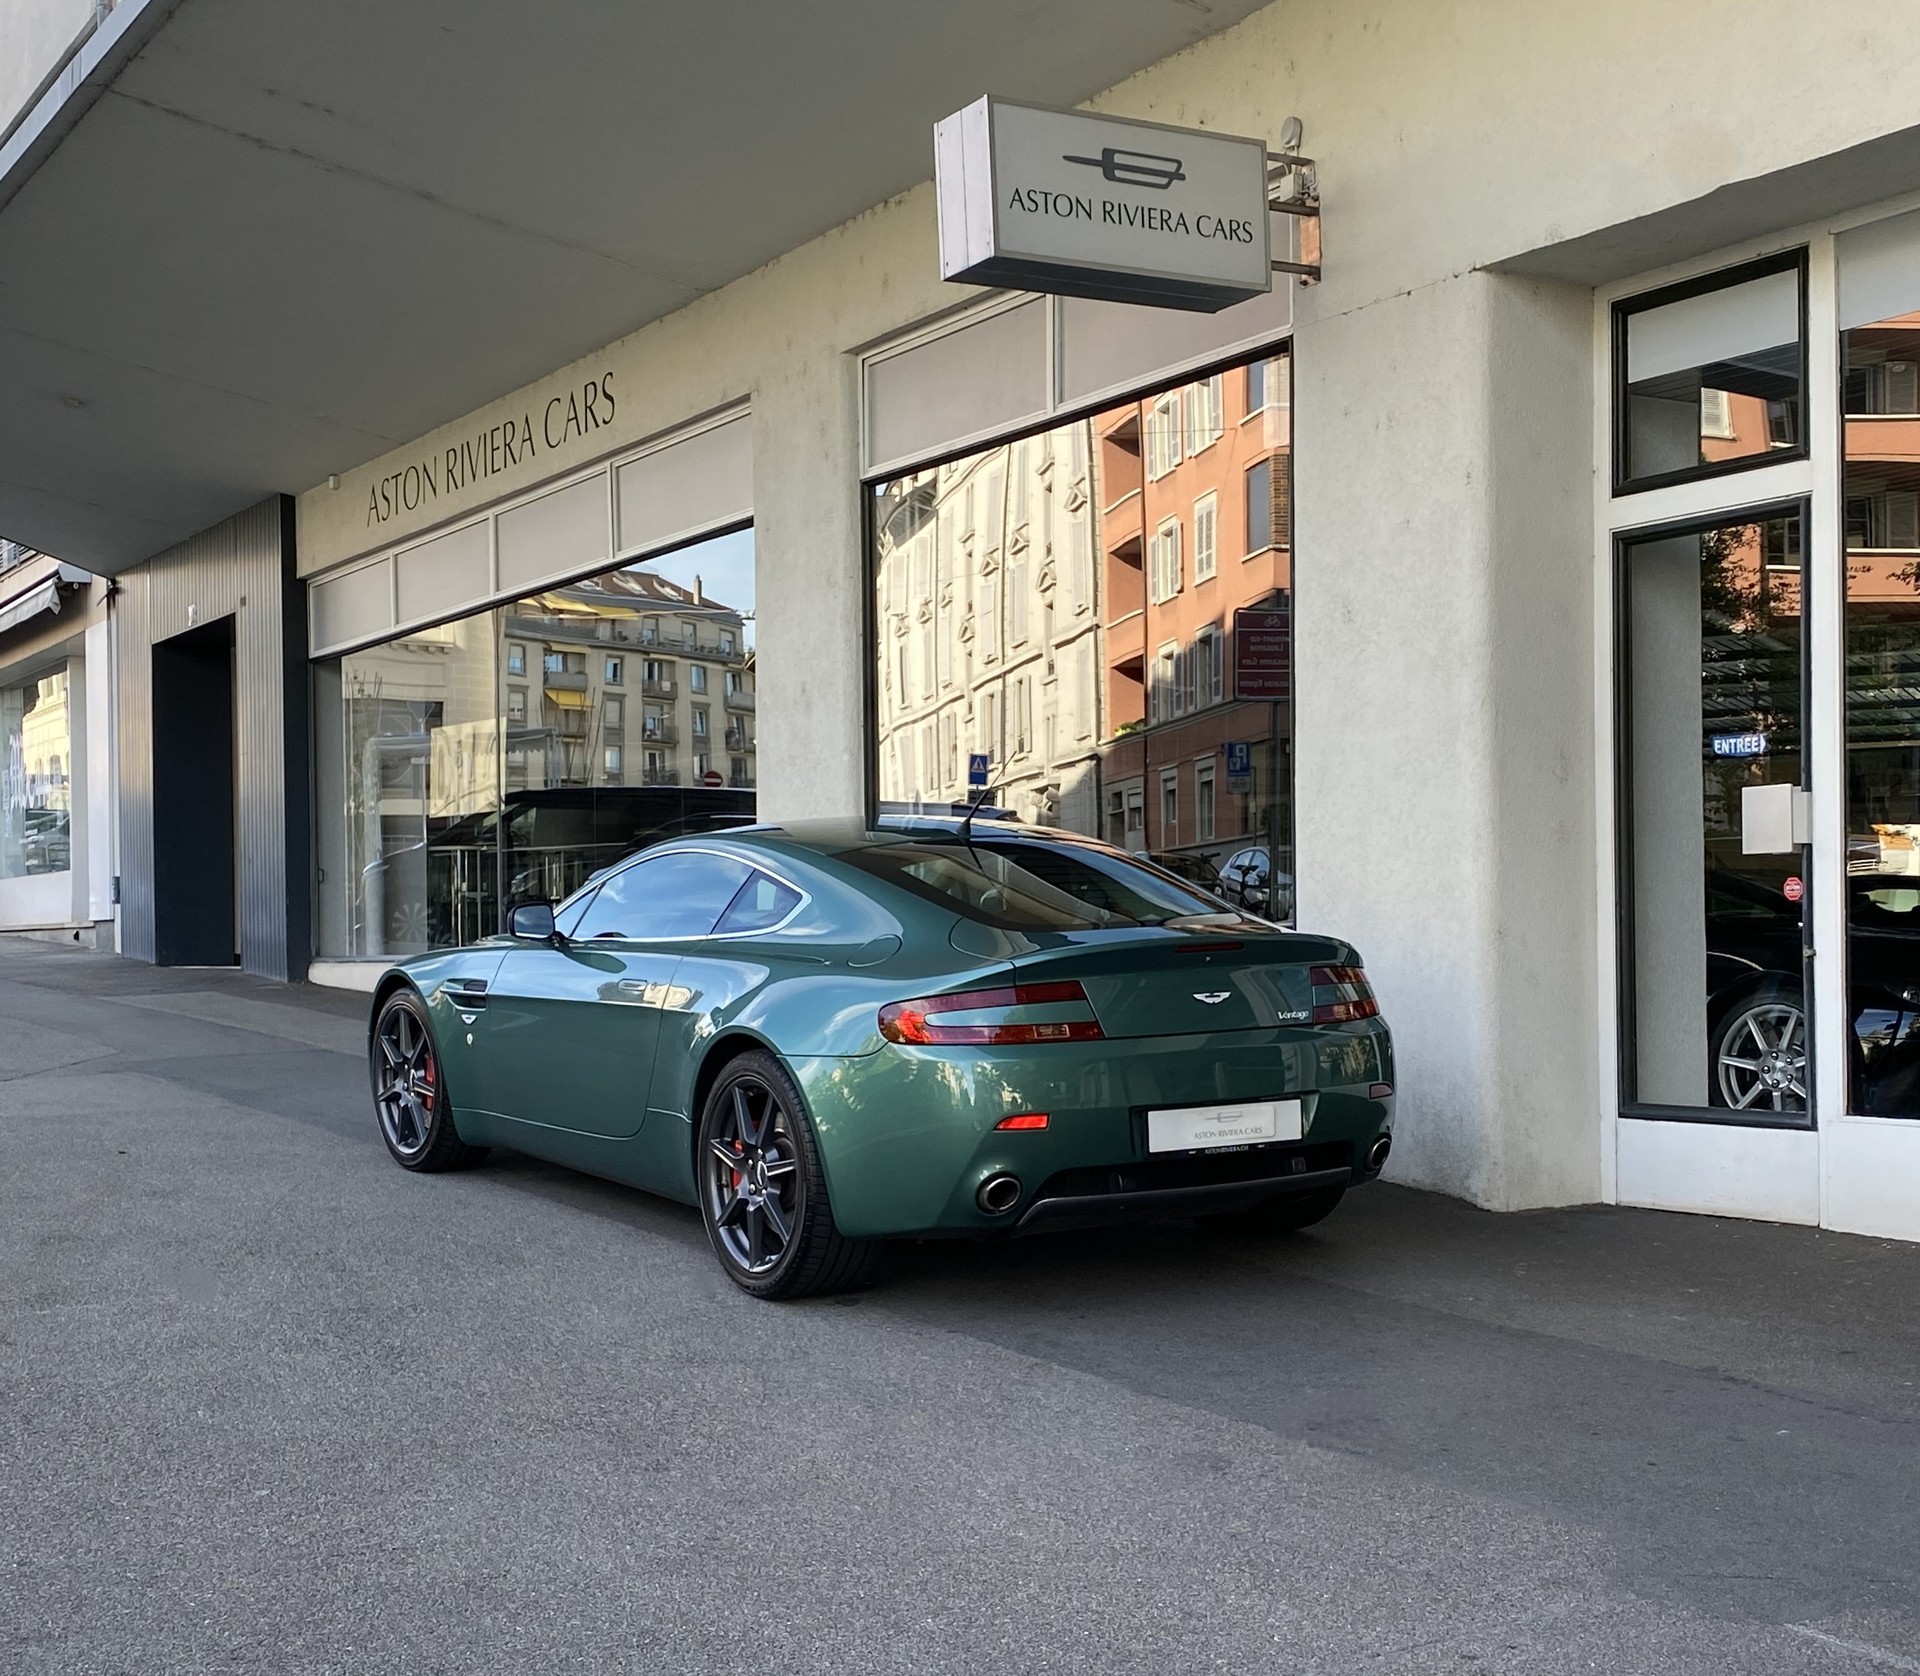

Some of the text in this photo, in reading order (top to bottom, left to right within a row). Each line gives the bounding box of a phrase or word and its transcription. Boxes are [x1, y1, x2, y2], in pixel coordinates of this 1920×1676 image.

[1009, 187, 1254, 244] ASTON RIVIERA CARS
[367, 372, 615, 527] ASTON RIVIERA CARS
[1277, 1010, 1309, 1020] Vantage
[1194, 1126, 1263, 1140] ASTON RIVIERA CARS
